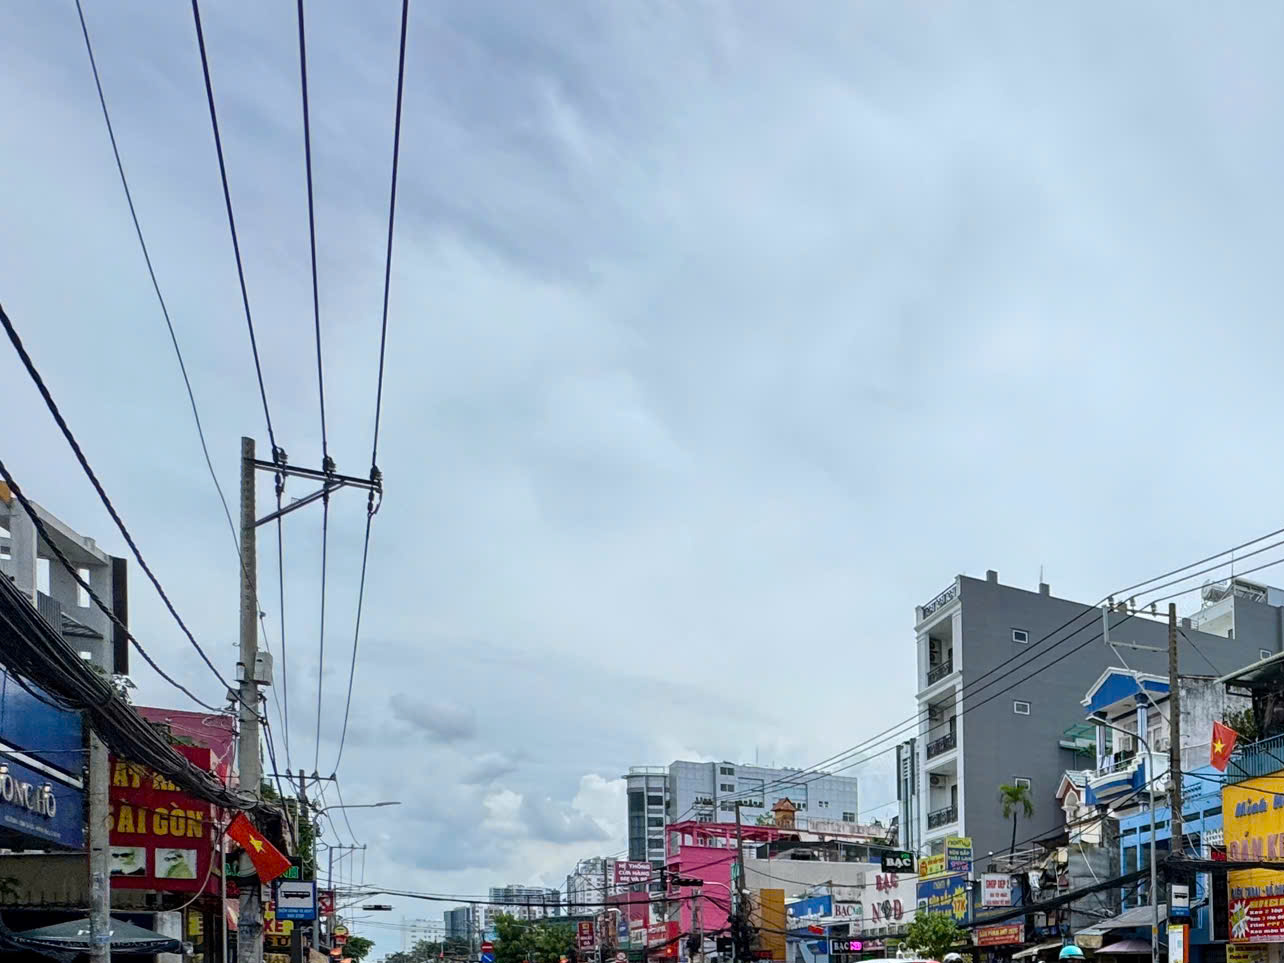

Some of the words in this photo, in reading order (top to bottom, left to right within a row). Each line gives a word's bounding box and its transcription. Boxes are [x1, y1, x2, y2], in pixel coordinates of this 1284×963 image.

[153, 803, 204, 838] GÒN
[1229, 831, 1263, 862] DÁN
[886, 858, 911, 868] BẠC
